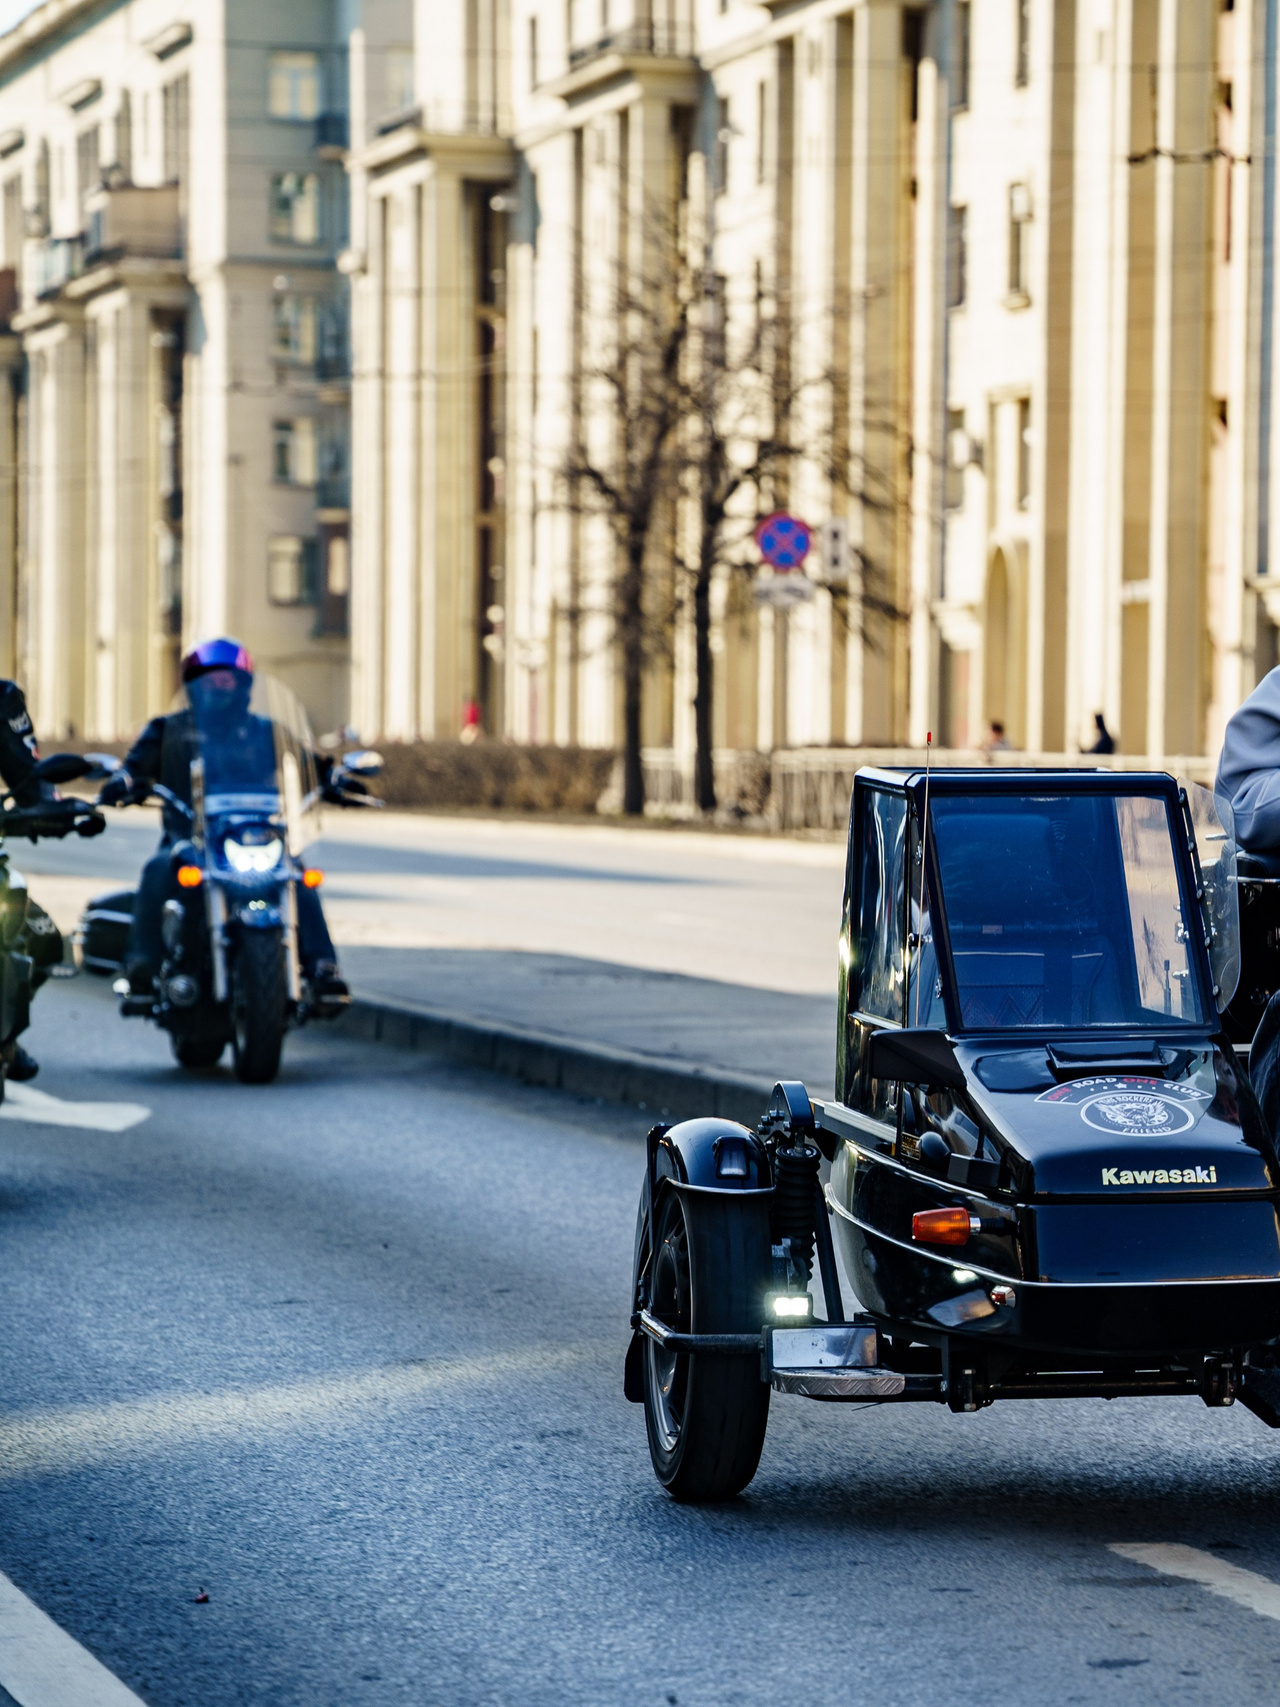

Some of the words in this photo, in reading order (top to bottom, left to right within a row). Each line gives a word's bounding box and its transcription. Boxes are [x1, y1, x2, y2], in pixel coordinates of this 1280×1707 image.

[1047, 1087, 1072, 1101] ONE
[1073, 1077, 1117, 1089] ROAD
[1122, 1077, 1158, 1086] ONE
[1163, 1083, 1202, 1098] CLUB
[1122, 1126, 1172, 1134] FRIEND
[1101, 1165, 1217, 1186] Kawasaki
